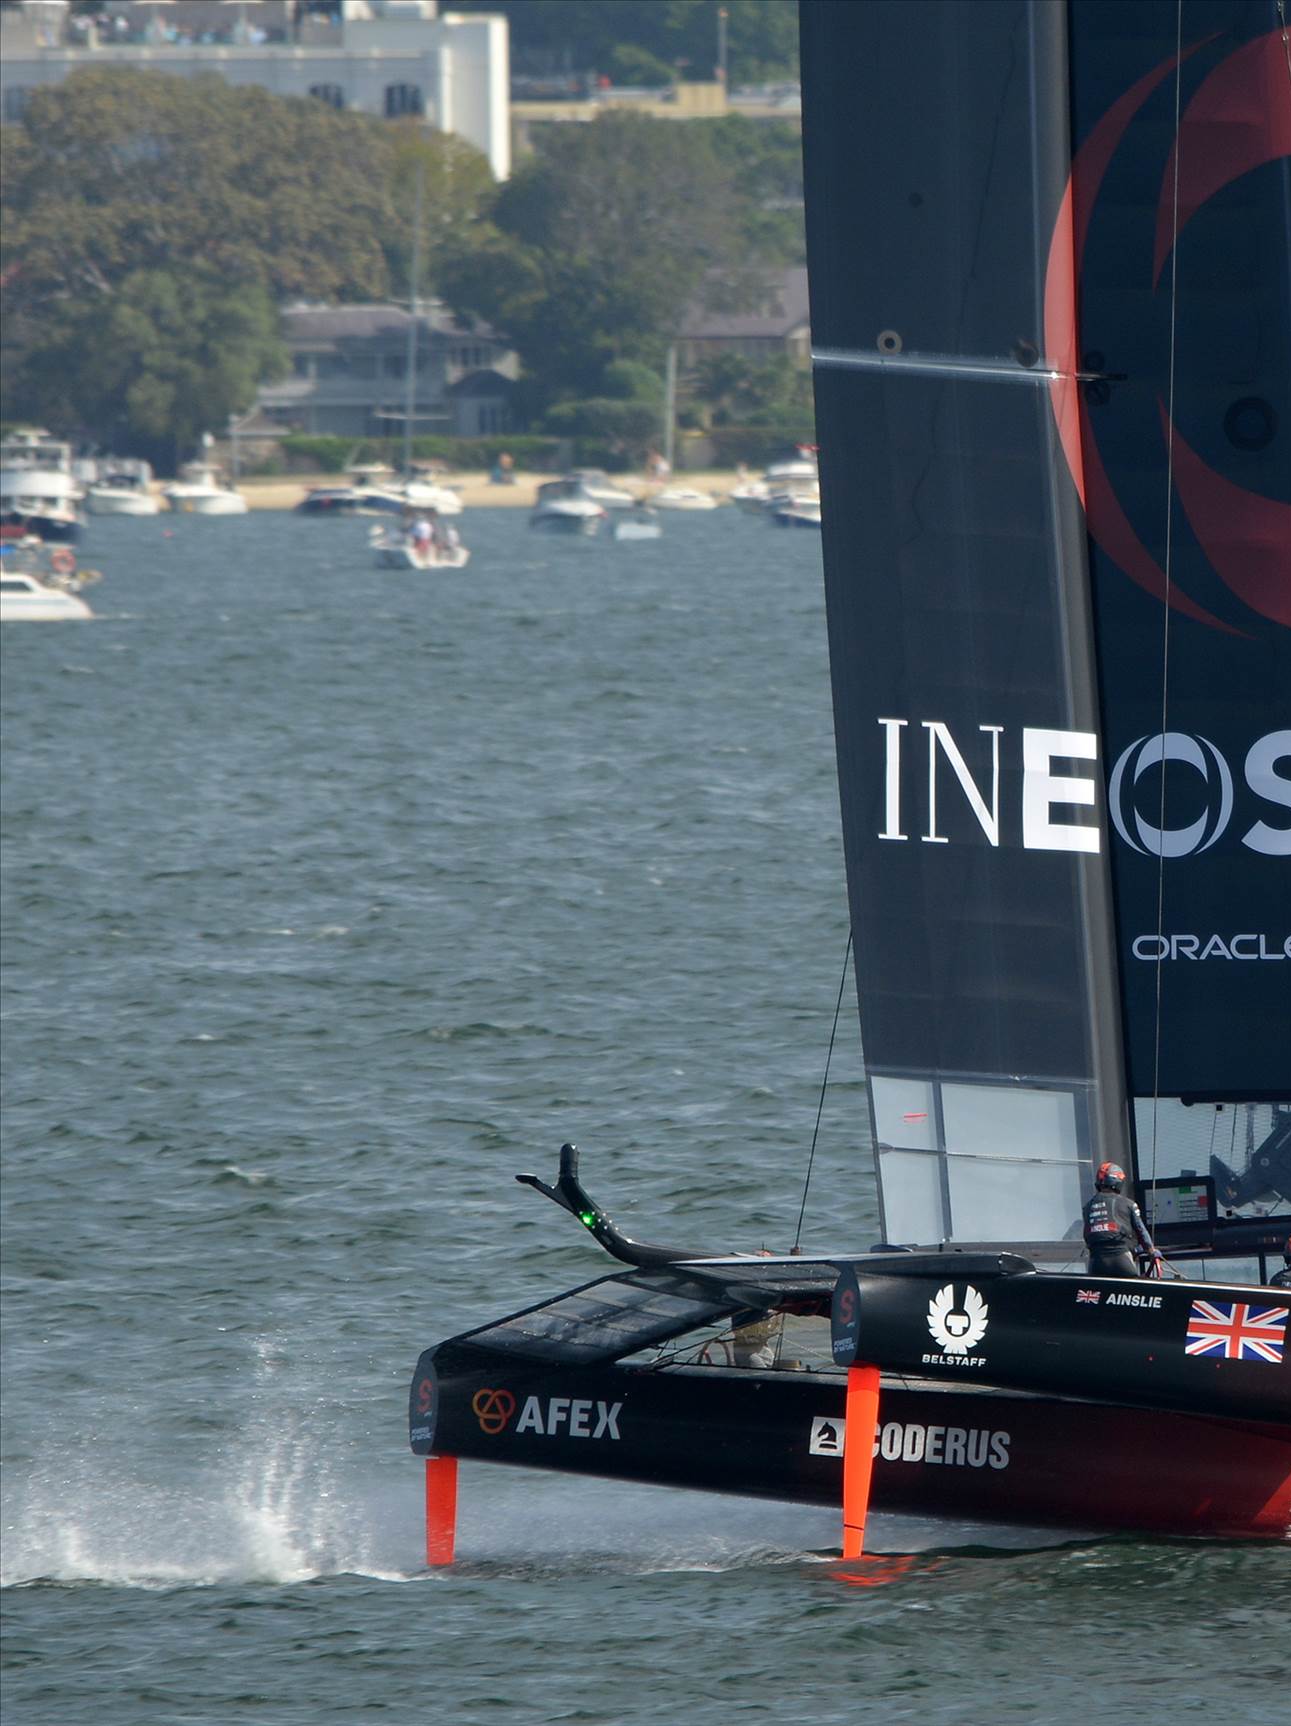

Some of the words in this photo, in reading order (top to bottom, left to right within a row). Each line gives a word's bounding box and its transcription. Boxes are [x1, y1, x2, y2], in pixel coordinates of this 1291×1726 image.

[1105, 1293, 1163, 1309] AINSLIE
[921, 1353, 987, 1367] BELSTAFF
[515, 1395, 624, 1440] AFEX
